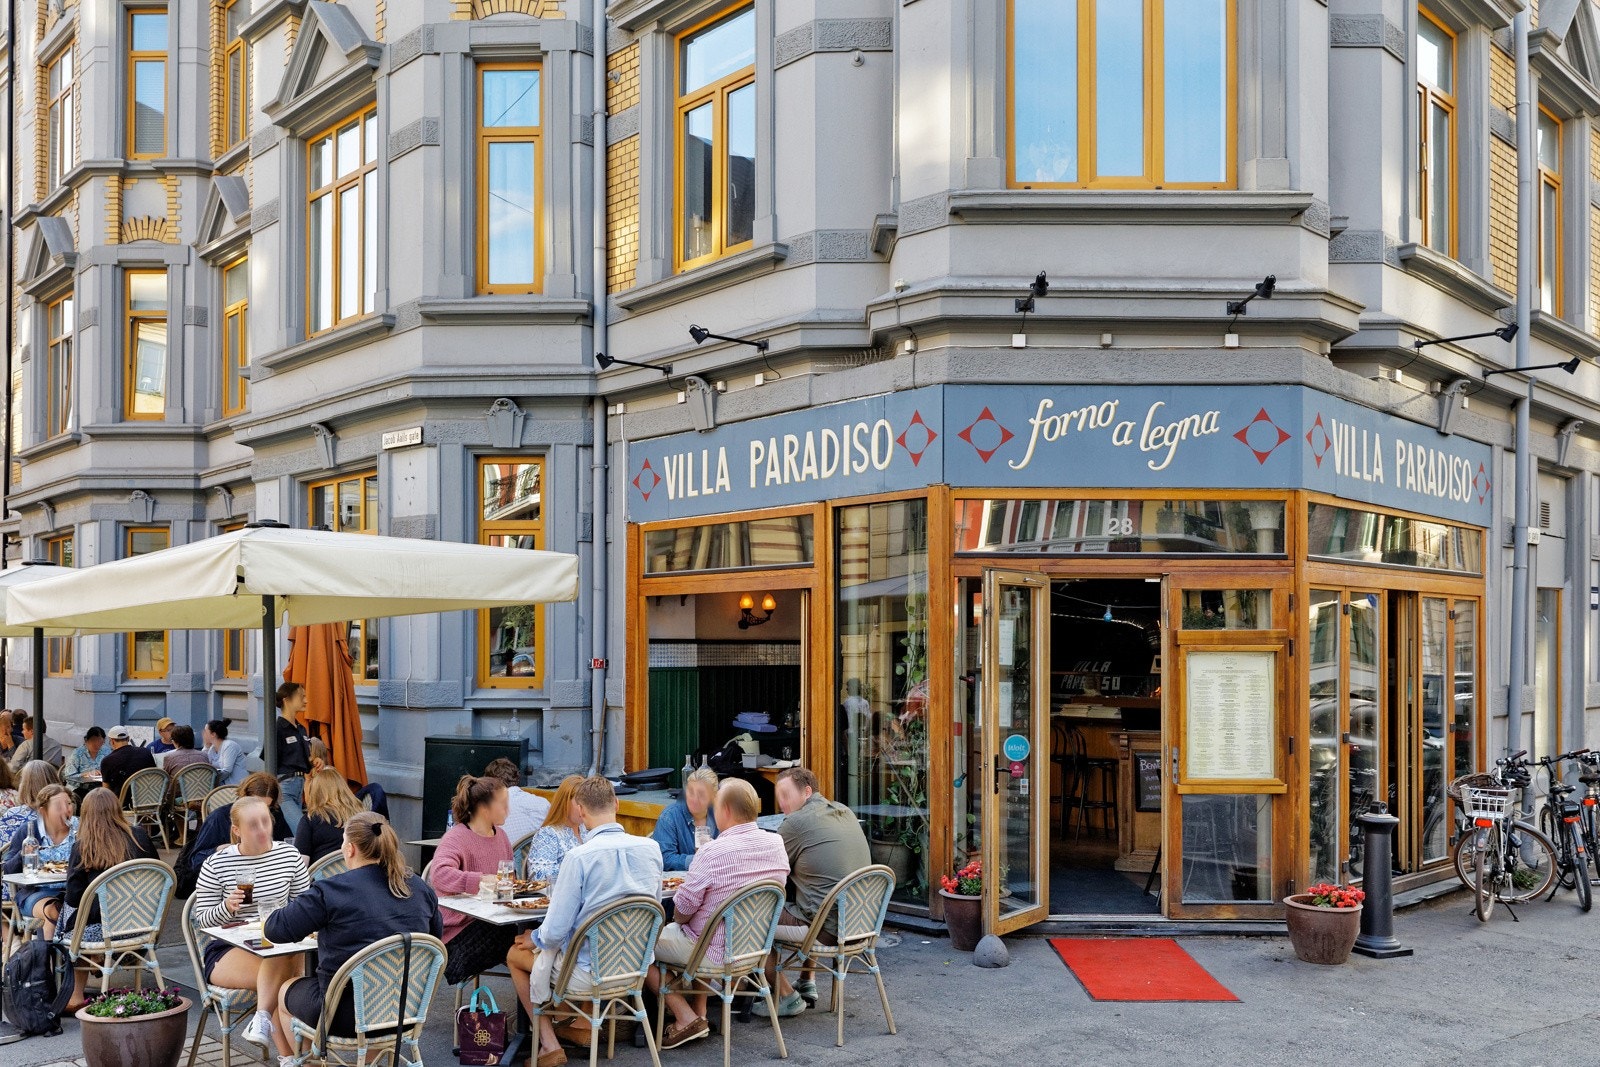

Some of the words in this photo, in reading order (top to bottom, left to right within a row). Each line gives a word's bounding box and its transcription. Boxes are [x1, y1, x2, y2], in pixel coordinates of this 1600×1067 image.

[663, 446, 731, 501] VILLA
[750, 418, 894, 489] PARADISO
[1008, 398, 1119, 471] forno
[1112, 421, 1136, 447] a
[1139, 401, 1221, 471] legna
[1331, 418, 1384, 484] VILLA
[1396, 439, 1473, 504] PARADISO
[1107, 517, 1134, 536] 28
[1060, 674, 1121, 691] PARASO
